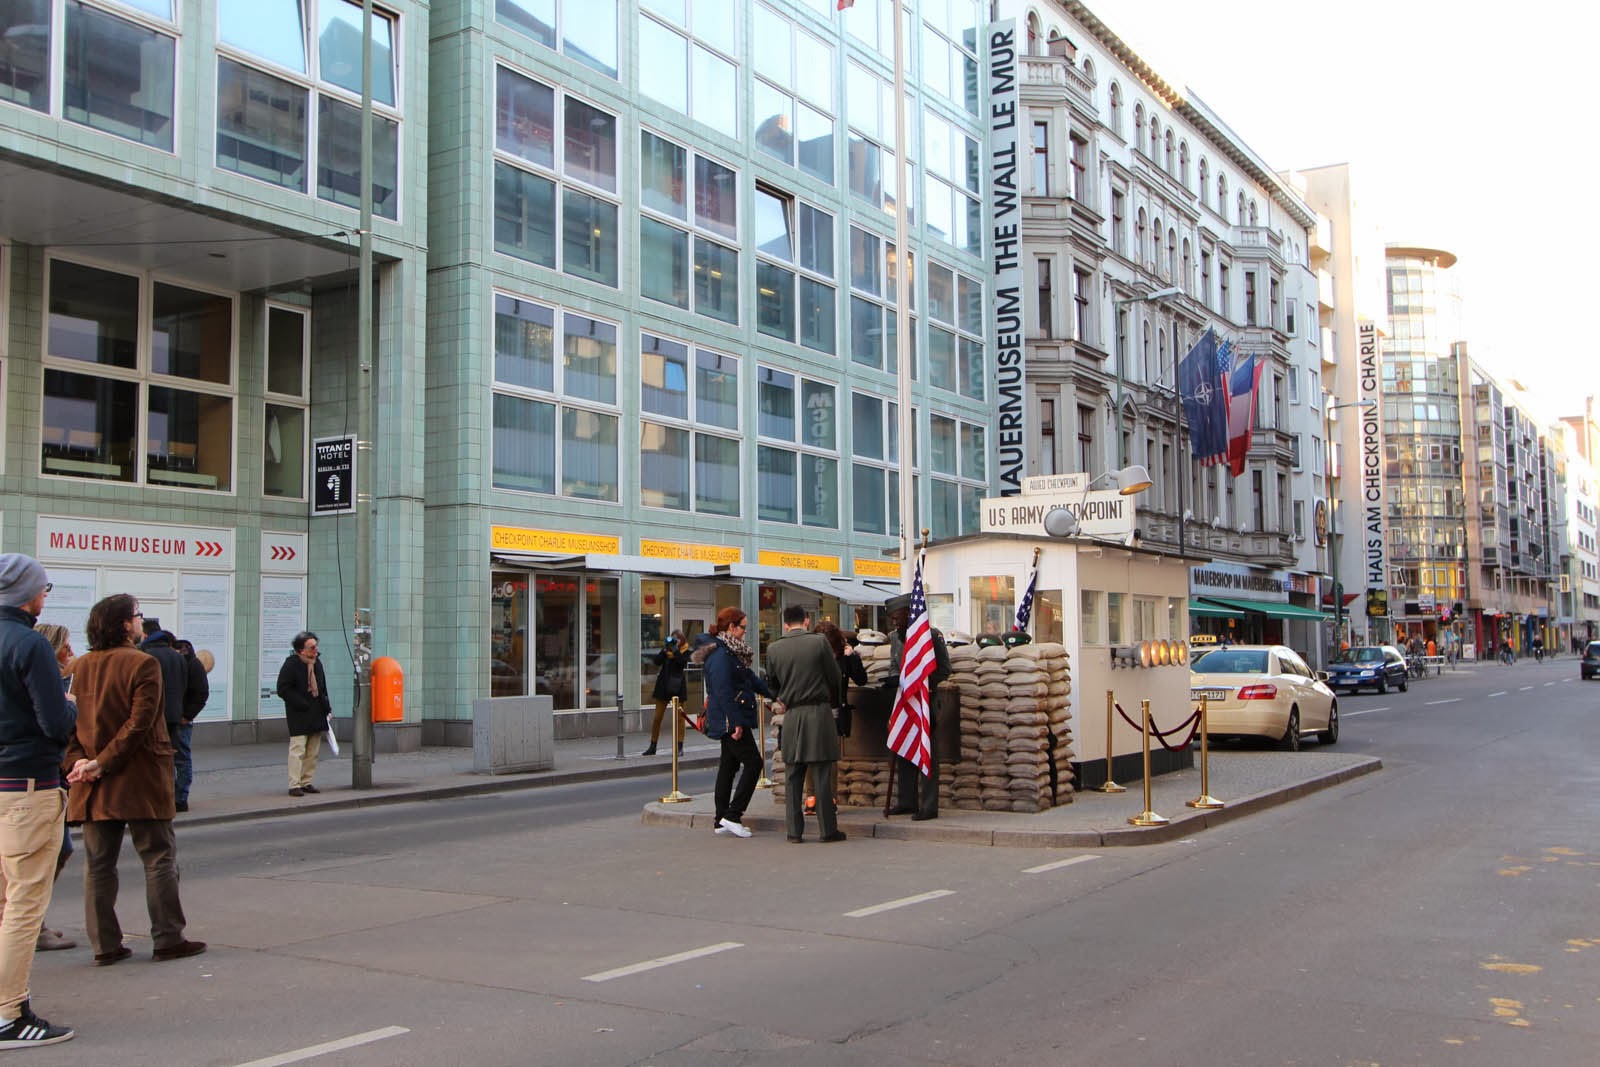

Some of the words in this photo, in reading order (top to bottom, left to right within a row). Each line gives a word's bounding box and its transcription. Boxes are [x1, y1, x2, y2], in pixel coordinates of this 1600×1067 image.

[991, 28, 1014, 95] MUR
[992, 101, 1015, 131] LE
[993, 141, 1017, 219] WALL
[995, 224, 1018, 275] THE
[1360, 324, 1376, 391] CHARLIE
[317, 443, 351, 454] TITANC
[320, 451, 349, 460] HOTEL
[1364, 397, 1381, 501] CHECKPOIN
[1030, 480, 1046, 491] ALLIED
[1047, 476, 1079, 490] CHECKPOINT
[1012, 505, 1045, 525] ARMY
[1050, 500, 1124, 521] CKPOINT
[1367, 506, 1382, 533] AM
[50, 532, 186, 555] MAUERMUSEUM
[494, 532, 538, 547] CHECKPOINT
[538, 537, 566, 549] CHARLIE
[780, 556, 801, 568] SINCE
[1368, 539, 1383, 583] HAUS
[1193, 568, 1233, 589] MAUERSHOP
[1233, 574, 1242, 589] IM
